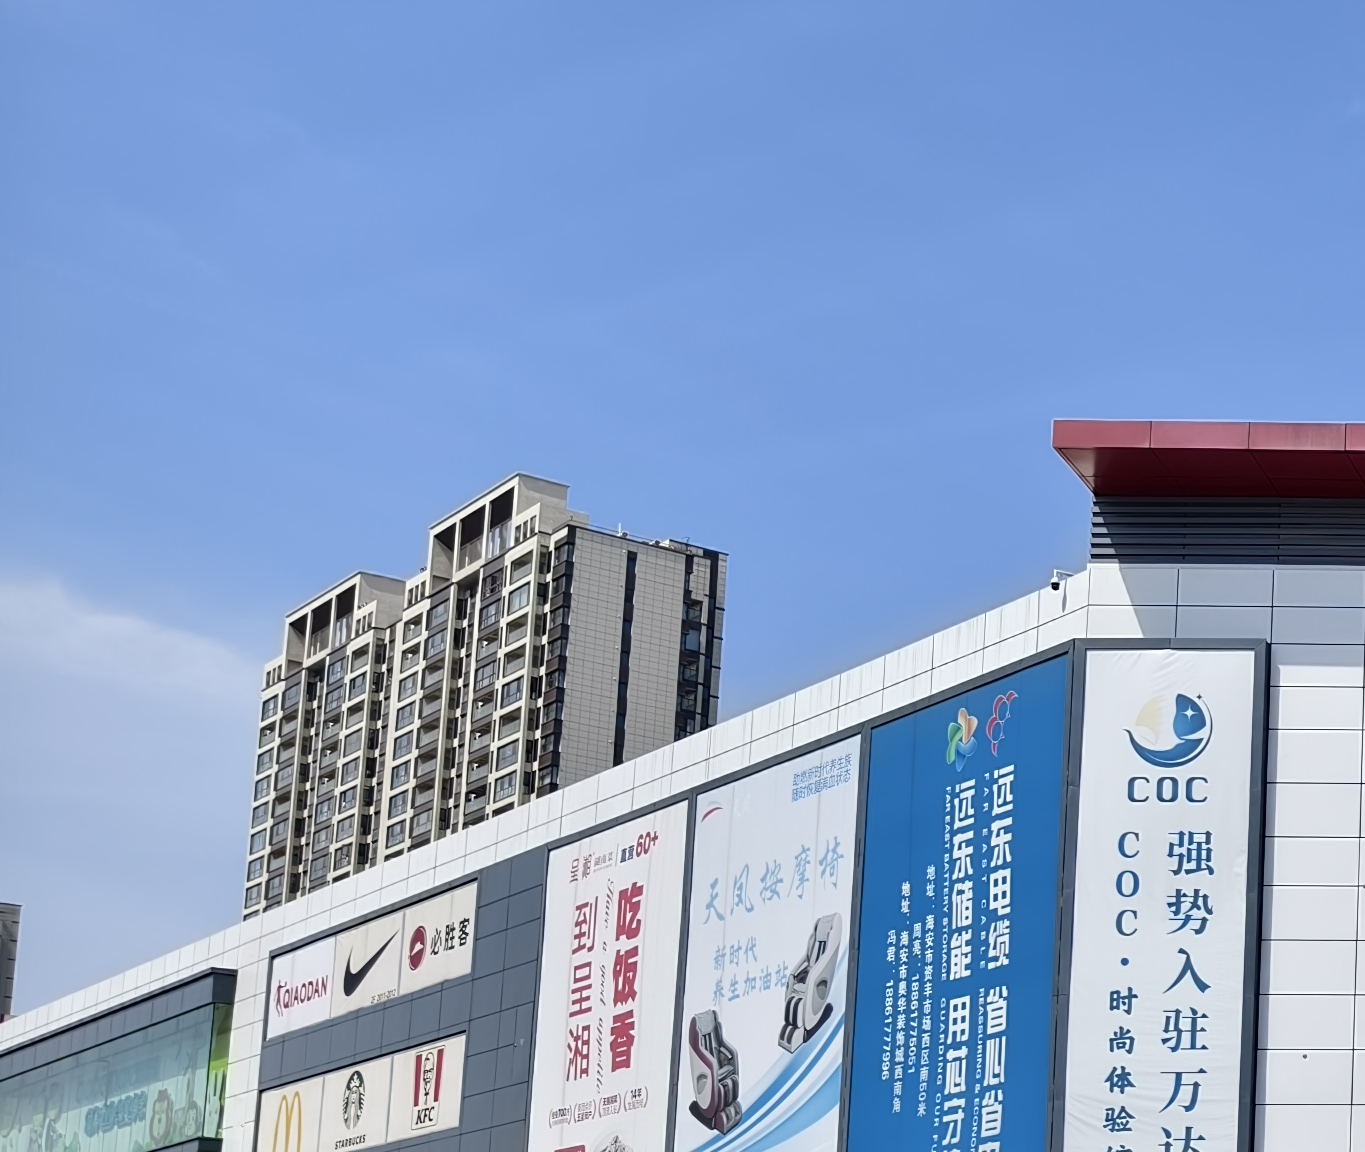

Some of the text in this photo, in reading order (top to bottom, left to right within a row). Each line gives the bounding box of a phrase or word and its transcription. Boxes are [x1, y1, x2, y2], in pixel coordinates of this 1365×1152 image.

[1127, 776, 1210, 803] COC
[950, 778, 976, 981] 远东储能
[987, 764, 1015, 970] 远东电缆
[430, 917, 471, 956] 必胜客
[713, 936, 758, 973] 新时代
[282, 974, 329, 1010] QIAODAN
[566, 895, 599, 1082] 到呈湘
[609, 881, 644, 1074] 吃饭香
[712, 961, 789, 1006] 养生加油站
[415, 1106, 435, 1125] KFC
[335, 1134, 367, 1150] STARBUCKS
